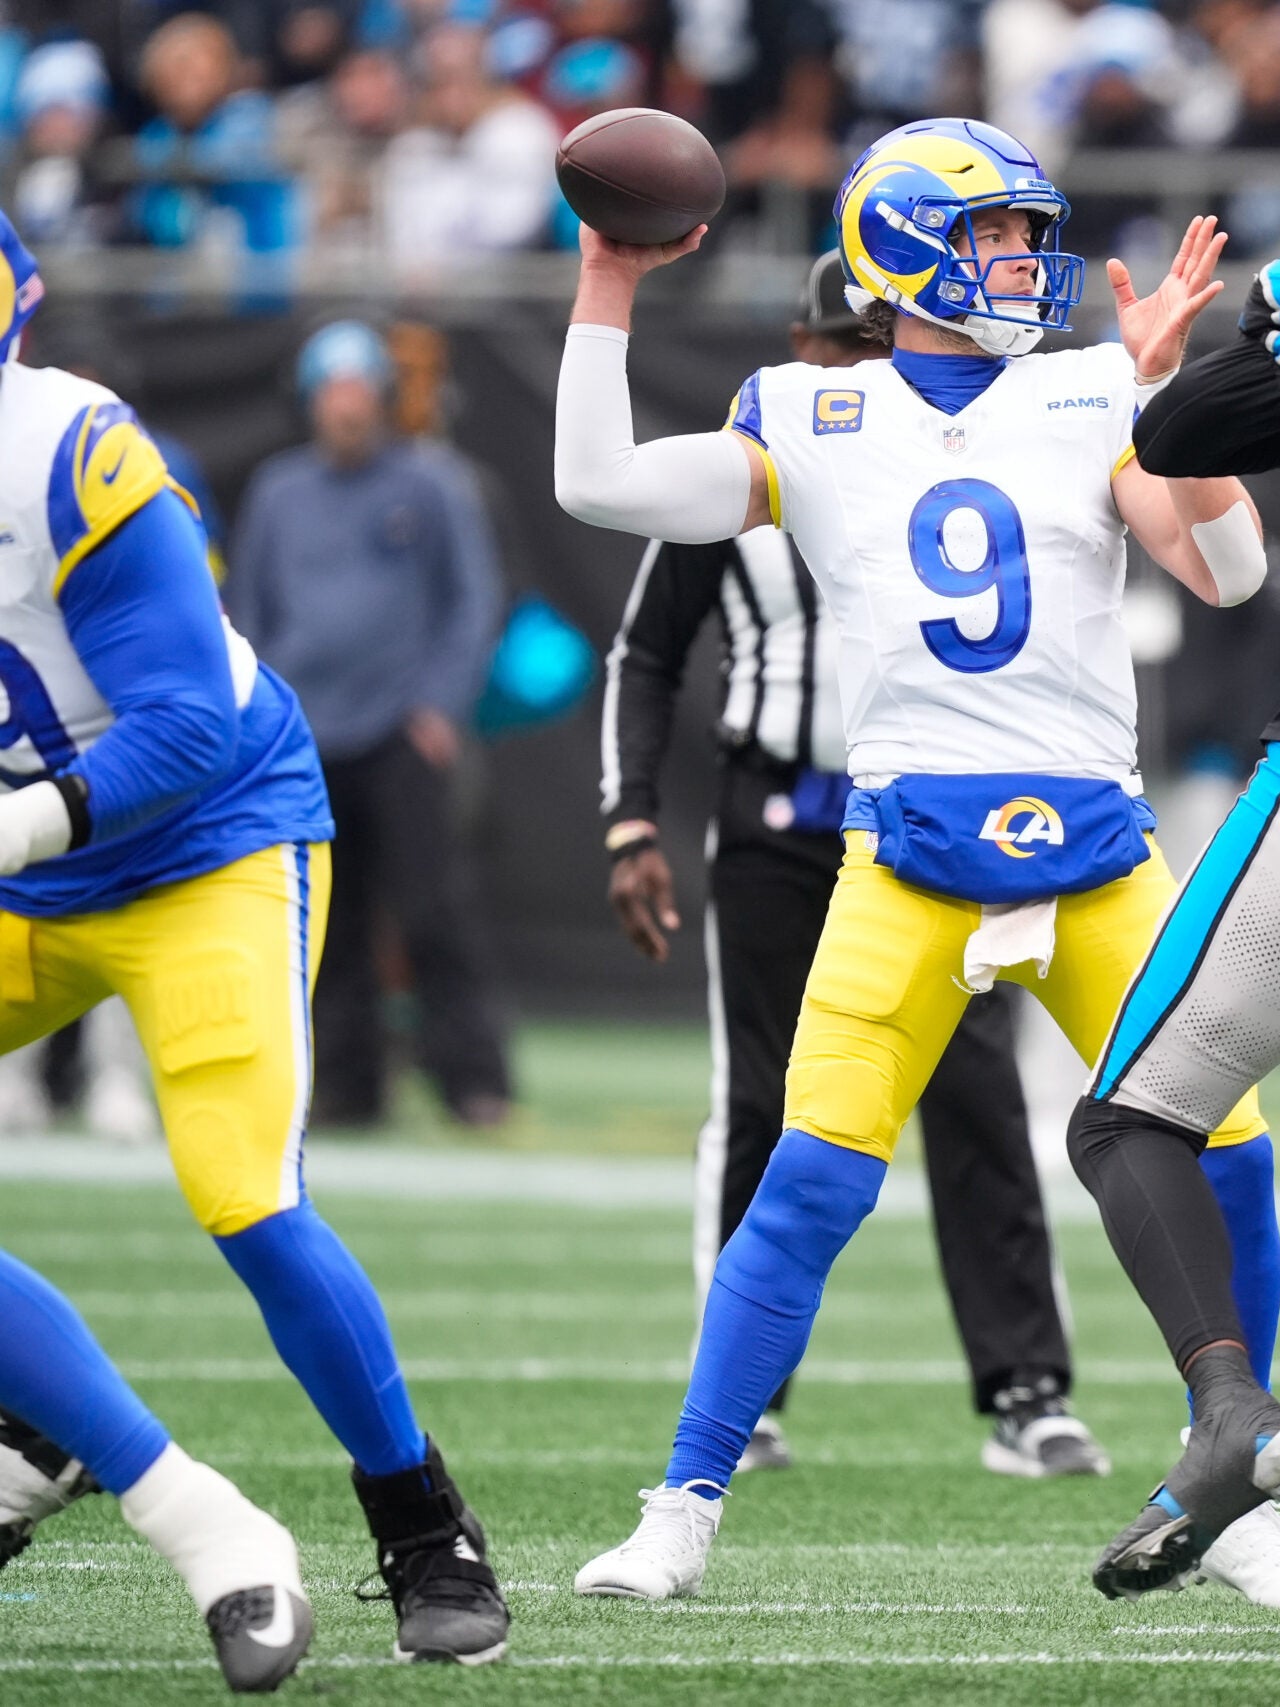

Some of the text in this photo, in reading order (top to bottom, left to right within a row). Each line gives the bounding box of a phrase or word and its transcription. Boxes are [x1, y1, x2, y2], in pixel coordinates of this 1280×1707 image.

[816, 391, 861, 422] C
[1047, 396, 1109, 411] RAMS
[908, 477, 1033, 674] 9
[977, 797, 1064, 847] LA
